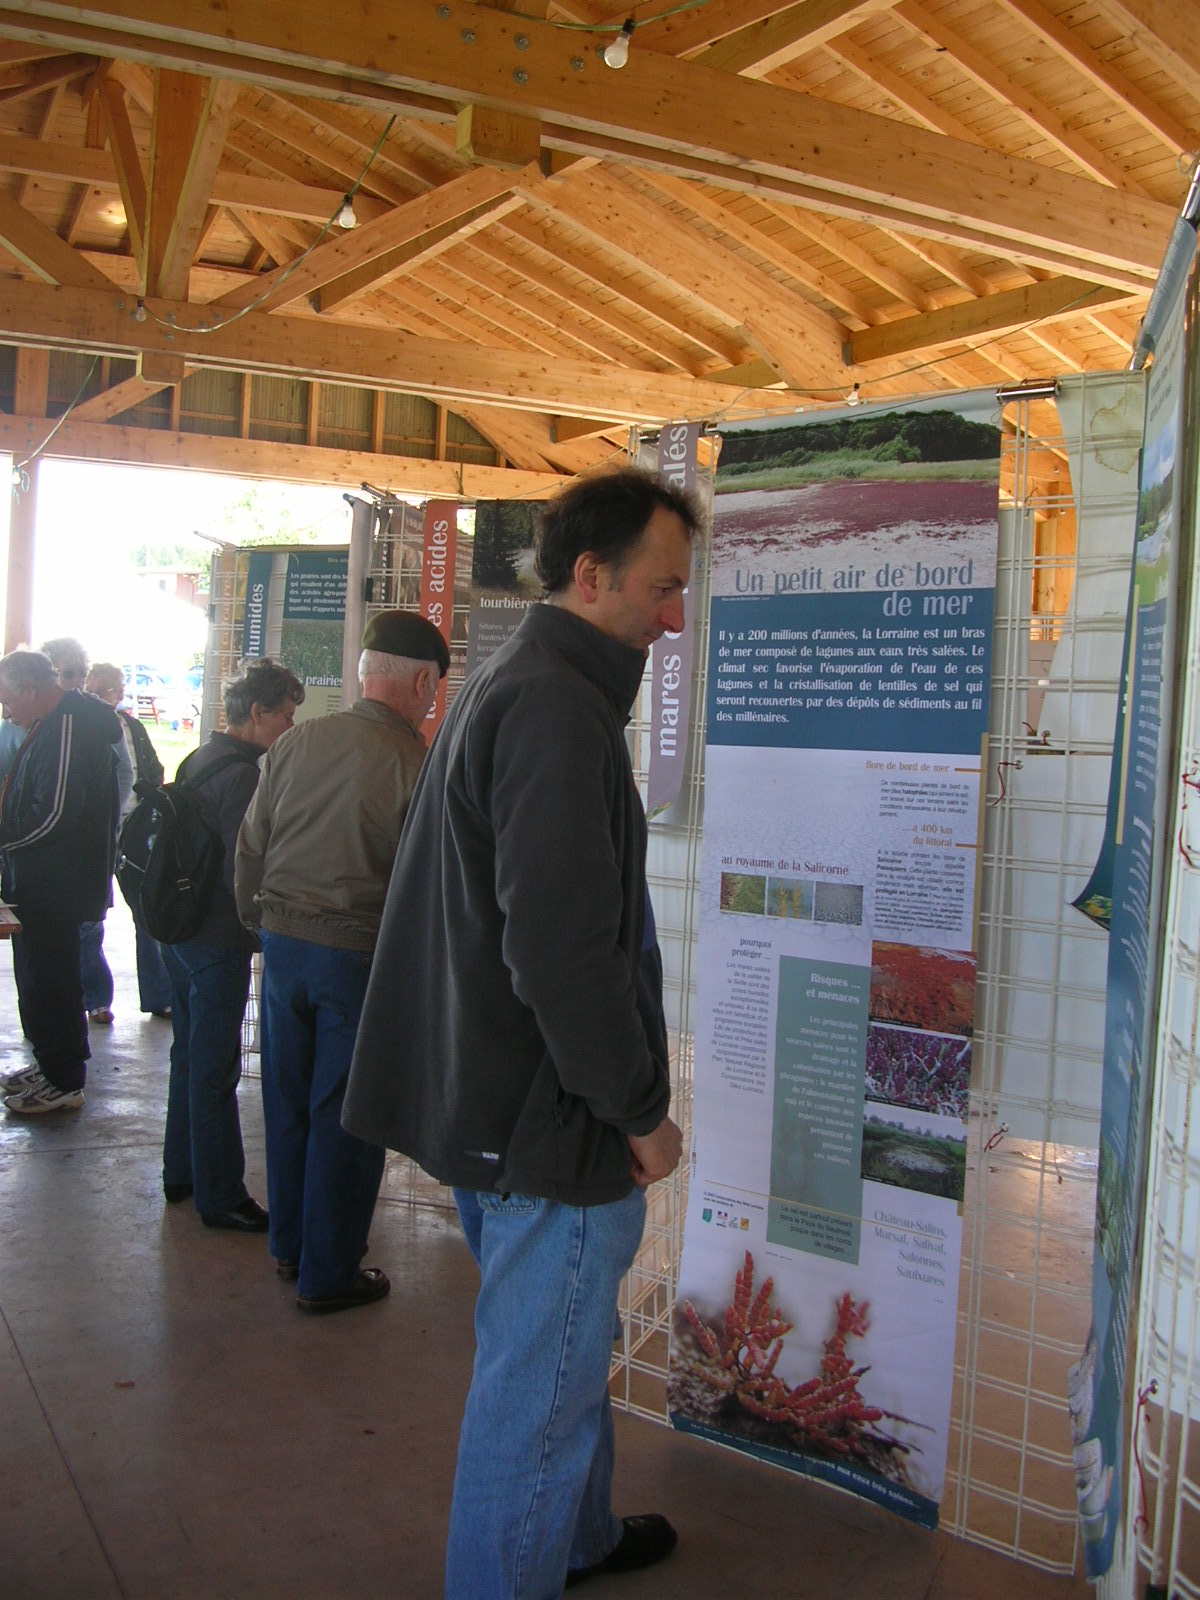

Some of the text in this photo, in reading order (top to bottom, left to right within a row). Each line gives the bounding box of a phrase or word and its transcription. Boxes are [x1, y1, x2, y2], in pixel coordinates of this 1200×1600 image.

[664, 425, 688, 488] alés
[428, 519, 449, 593] acides
[735, 559, 973, 595] Un petit air de bord
[883, 591, 973, 616] de mer
[246, 583, 263, 656] humides
[719, 628, 985, 643] Il y a 200 millions d'années, la Lorraine est un bras
[719, 646, 984, 659] de mer composé de lagunes aux eaux très salées. Le
[718, 662, 983, 676] climat sec favorise l'évaporation de l'eau de ces
[305, 674, 343, 687] prairies
[717, 679, 983, 694] lagunes et la cristallisation de lentilles de sel qui
[660, 654, 681, 756] mares
[716, 696, 982, 710] seront recouvertes par des dépôts de sédiments au fil
[716, 711, 789, 723] des millénaires.
[899, 762, 918, 772] bord
[921, 823, 938, 834] 400
[926, 836, 953, 848] littoral
[721, 856, 849, 876] au royaume de la Salicorne
[740, 938, 772, 948] pourquoi
[811, 972, 848, 987] Risques
[806, 989, 860, 1004] et menaces
